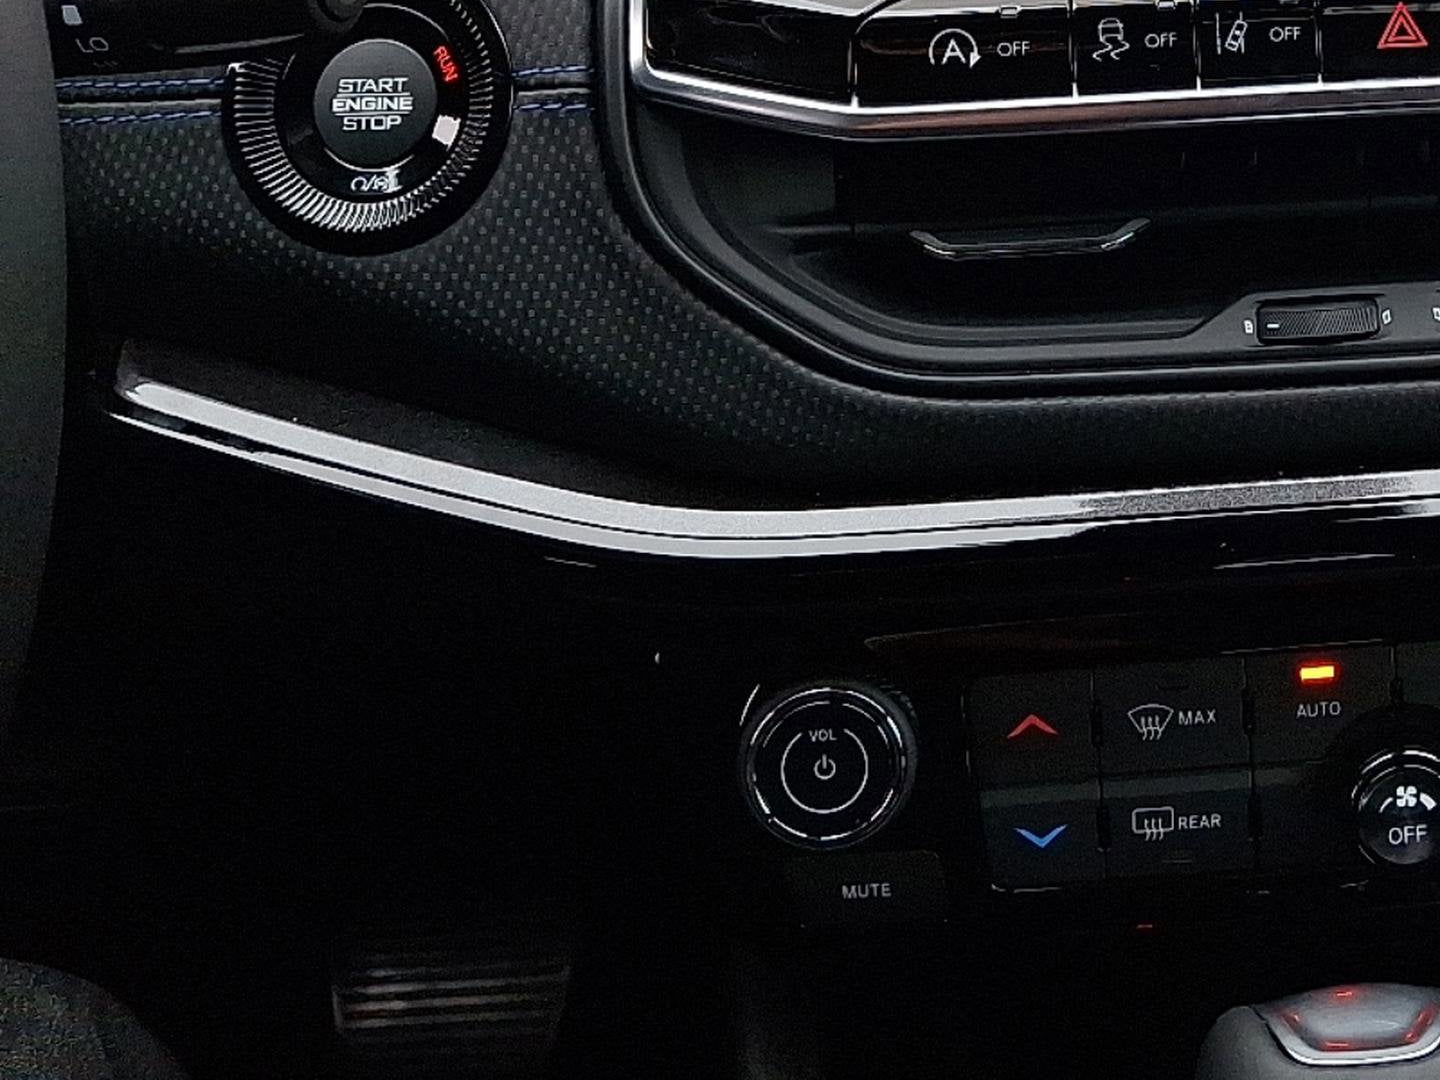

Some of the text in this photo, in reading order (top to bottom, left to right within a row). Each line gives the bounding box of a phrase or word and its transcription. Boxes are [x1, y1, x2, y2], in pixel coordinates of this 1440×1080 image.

[1145, 32, 1176, 48] OFF
[1269, 27, 1300, 42] OFF
[997, 41, 1029, 56] OFF
[434, 46, 458, 81] RUN
[338, 78, 408, 92] START
[332, 96, 413, 112] ENGINE
[342, 115, 402, 130] STOP
[1297, 702, 1341, 717] AUTO
[1179, 710, 1215, 725] MAX
[809, 729, 836, 742] VOL
[1179, 814, 1220, 829] REAR
[1389, 825, 1426, 844] OFF
[842, 883, 891, 898] MUTE
